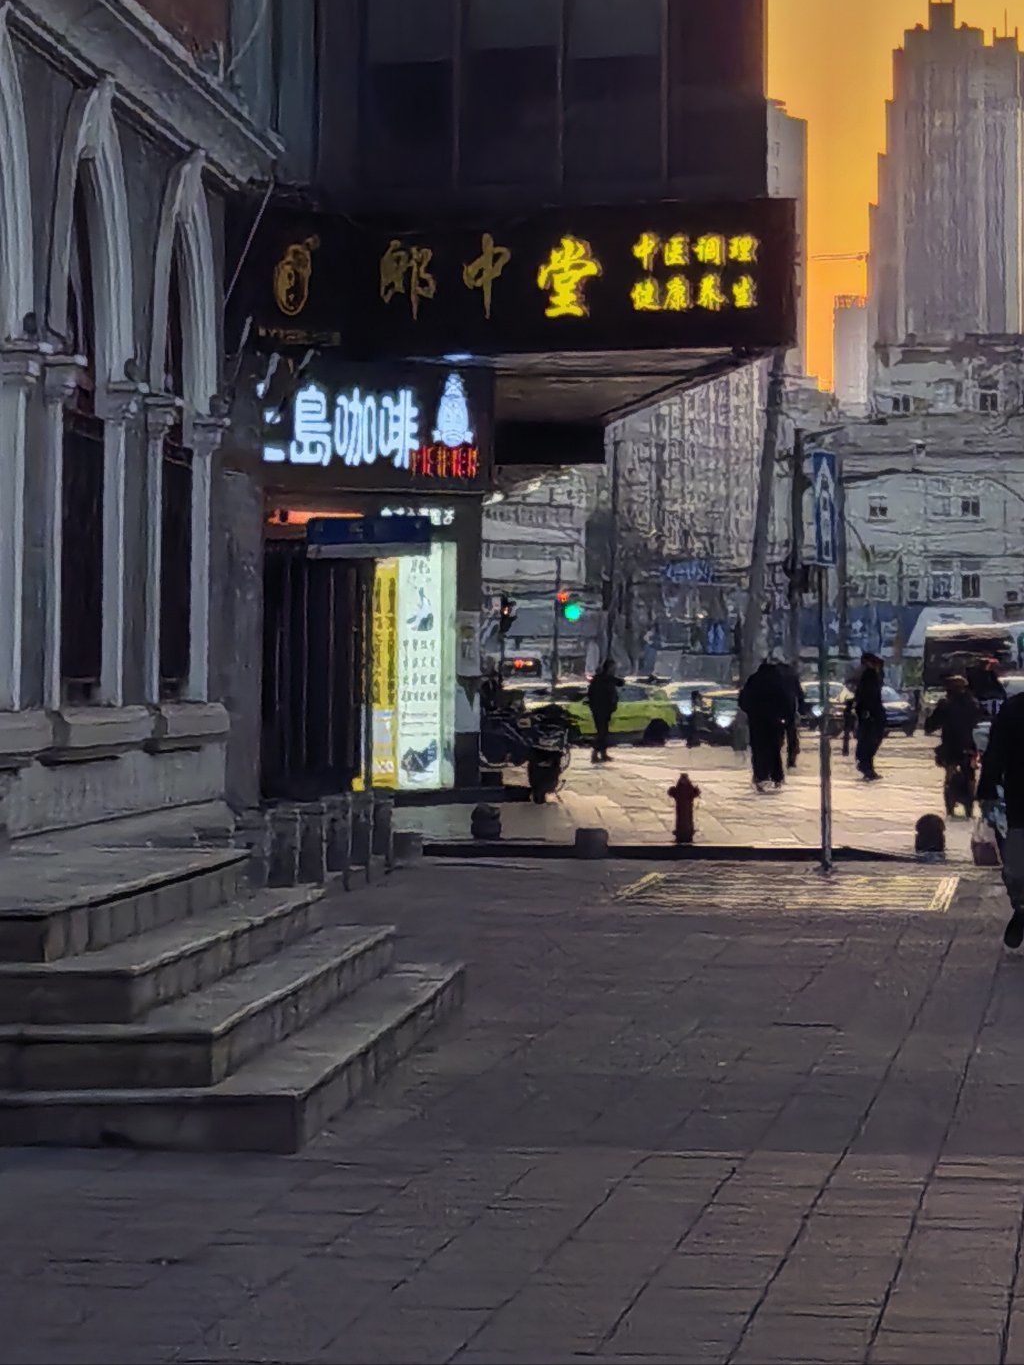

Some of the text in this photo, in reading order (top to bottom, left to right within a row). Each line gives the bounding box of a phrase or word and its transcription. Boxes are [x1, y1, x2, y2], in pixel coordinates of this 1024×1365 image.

[632, 233, 760, 271] 中医调理
[380, 232, 602, 320] 郎中堂
[630, 274, 758, 312] 健康养生
